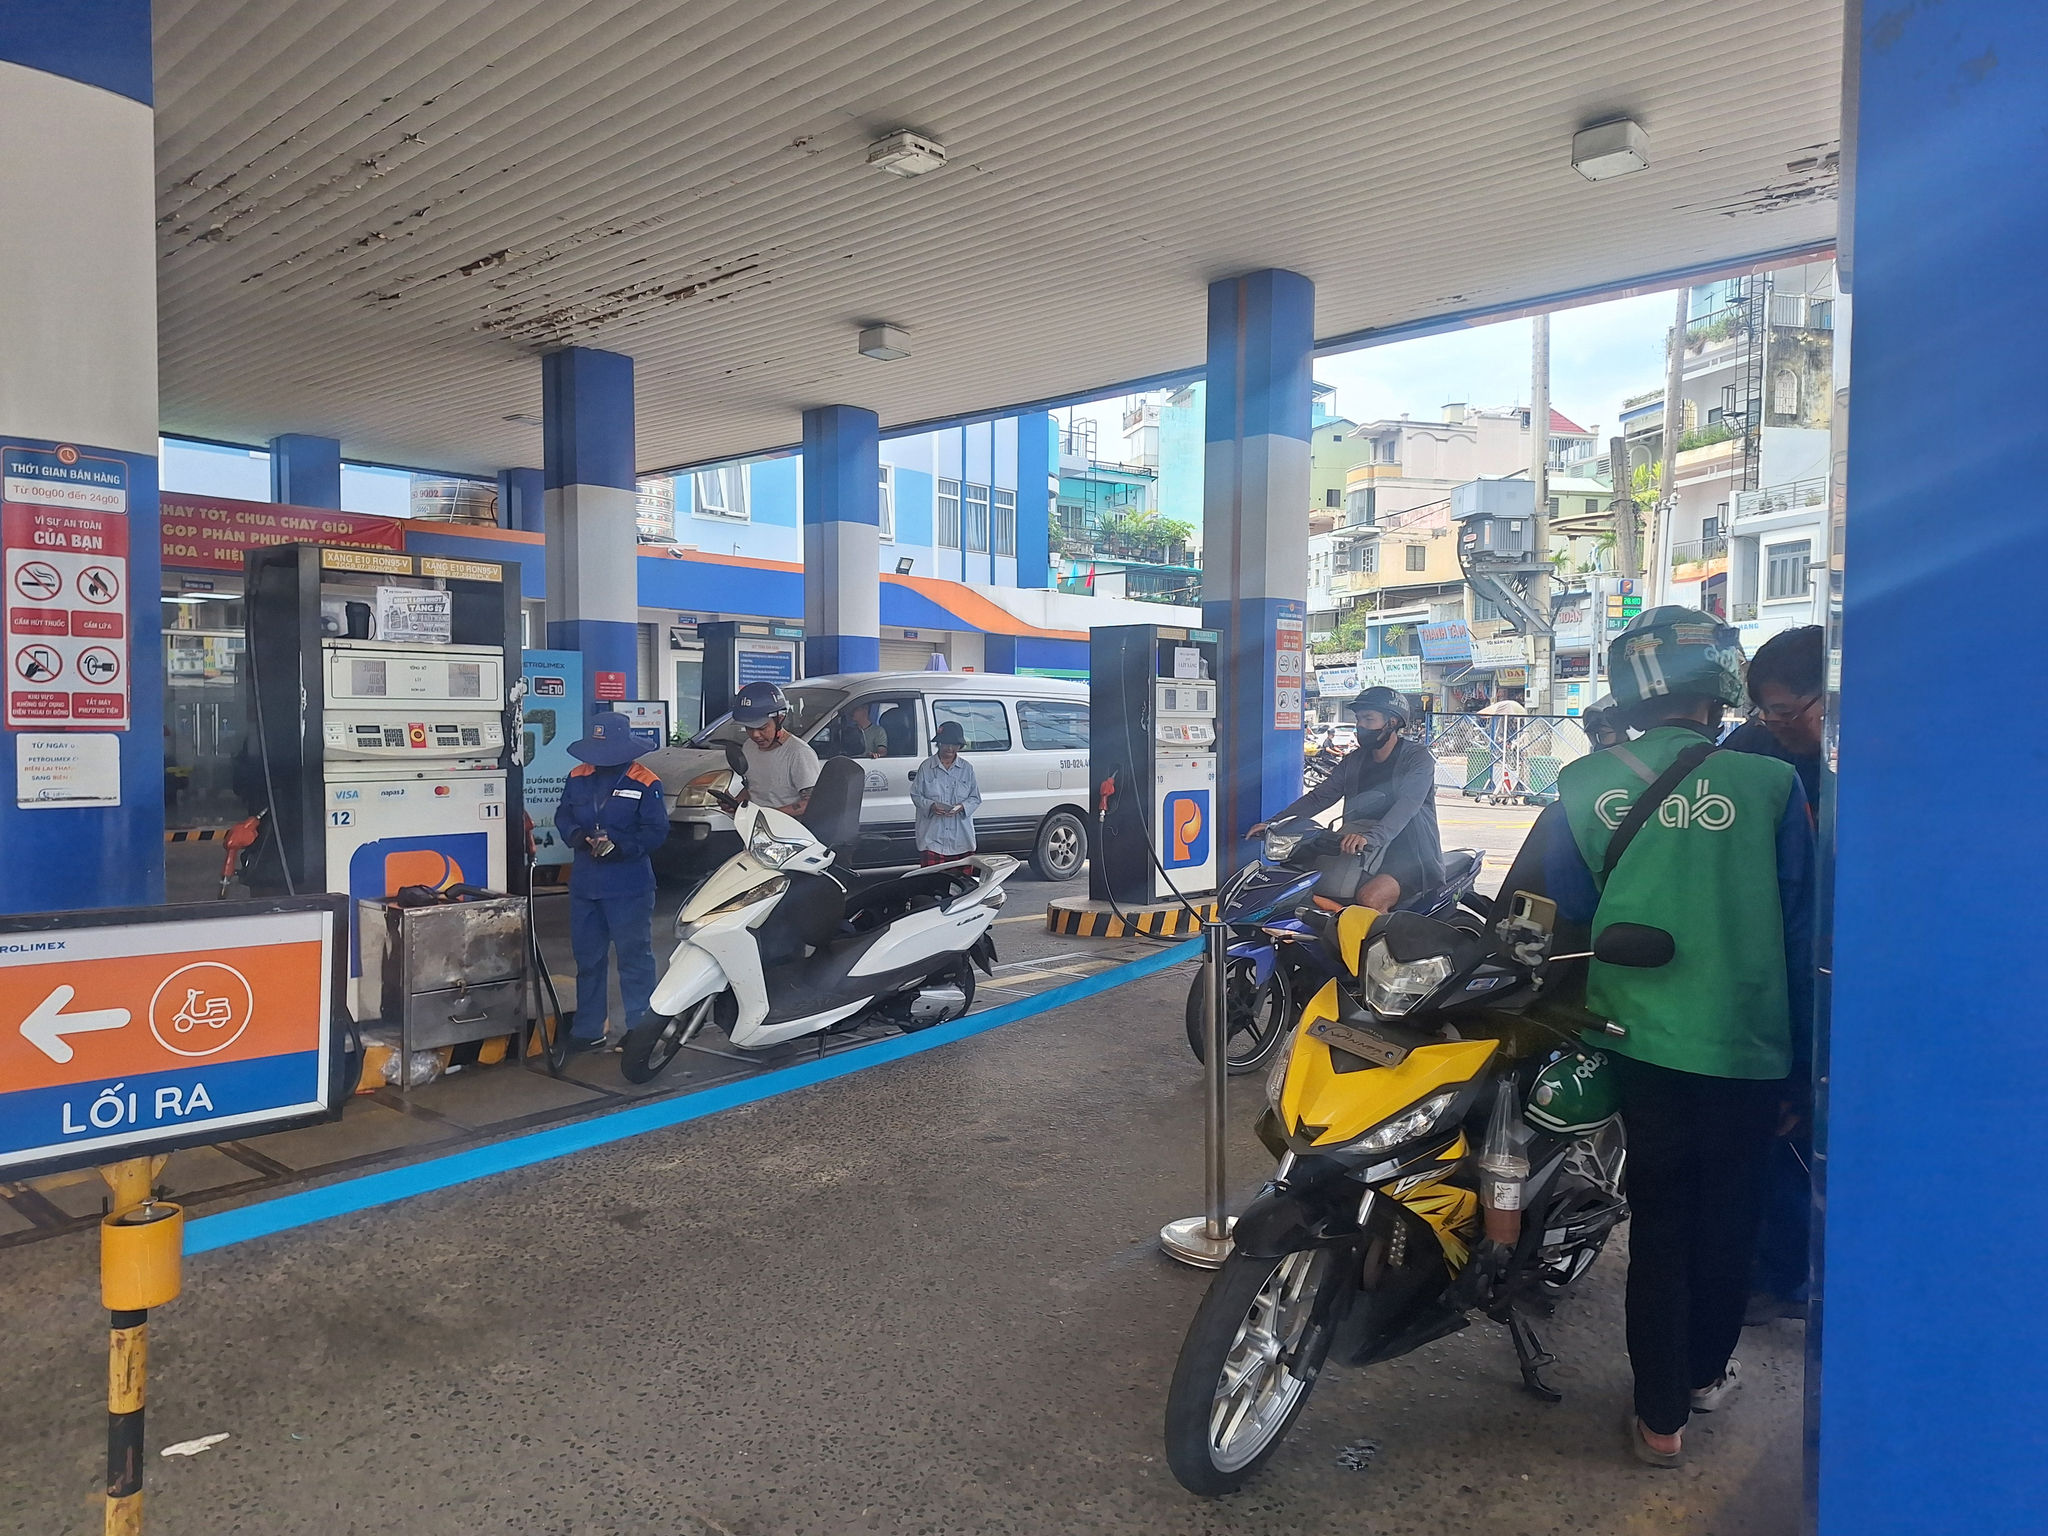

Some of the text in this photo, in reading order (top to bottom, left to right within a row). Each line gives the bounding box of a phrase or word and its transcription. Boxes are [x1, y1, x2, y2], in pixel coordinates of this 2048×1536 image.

[11, 463, 120, 485] THỜI GIAN BÁN HÀNG
[13, 484, 119, 504] Từ 00g00 đến 24g00
[34, 515, 102, 530] VÌ SỰ AN TOÀN
[34, 528, 103, 551] CỦA BẠN
[355, 555, 371, 565] E10
[372, 557, 409, 568] RON95-V
[450, 564, 464, 574] E10
[466, 566, 498, 577] RON95-V
[335, 790, 359, 800] VISA
[486, 805, 499, 818] 11
[1594, 779, 1736, 831] Gab
[331, 811, 350, 826] 12
[62, 1083, 214, 1135] LỐI RA
